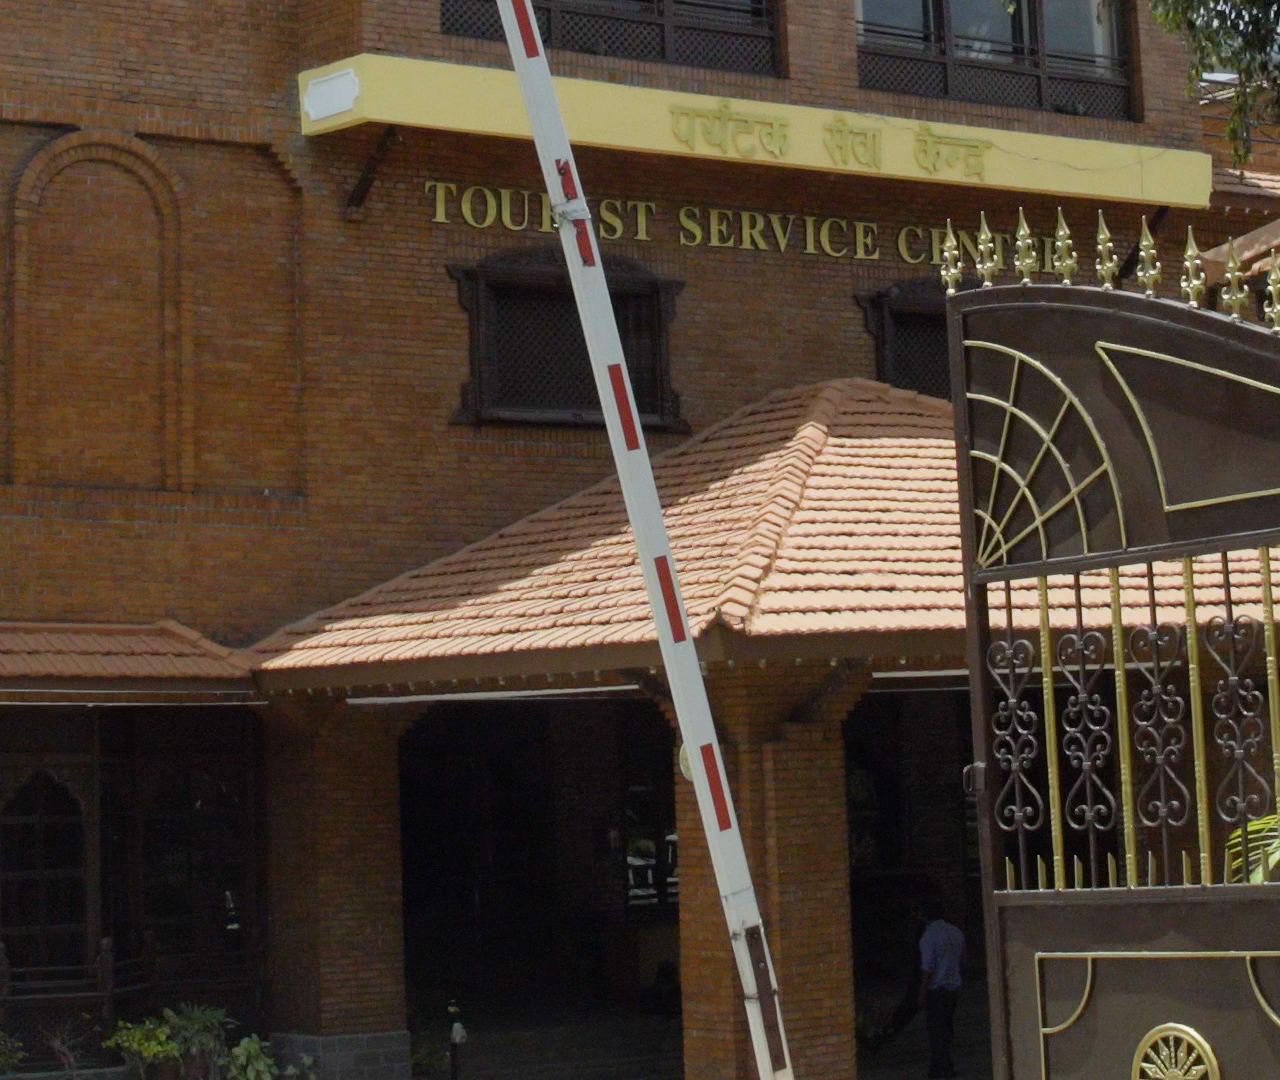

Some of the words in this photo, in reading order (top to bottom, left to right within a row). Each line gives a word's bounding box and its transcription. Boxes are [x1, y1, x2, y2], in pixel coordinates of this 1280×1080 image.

[823, 112, 882, 171] सेवा
[425, 180, 655, 241] TOUST
[678, 206, 880, 259] SERVICE
